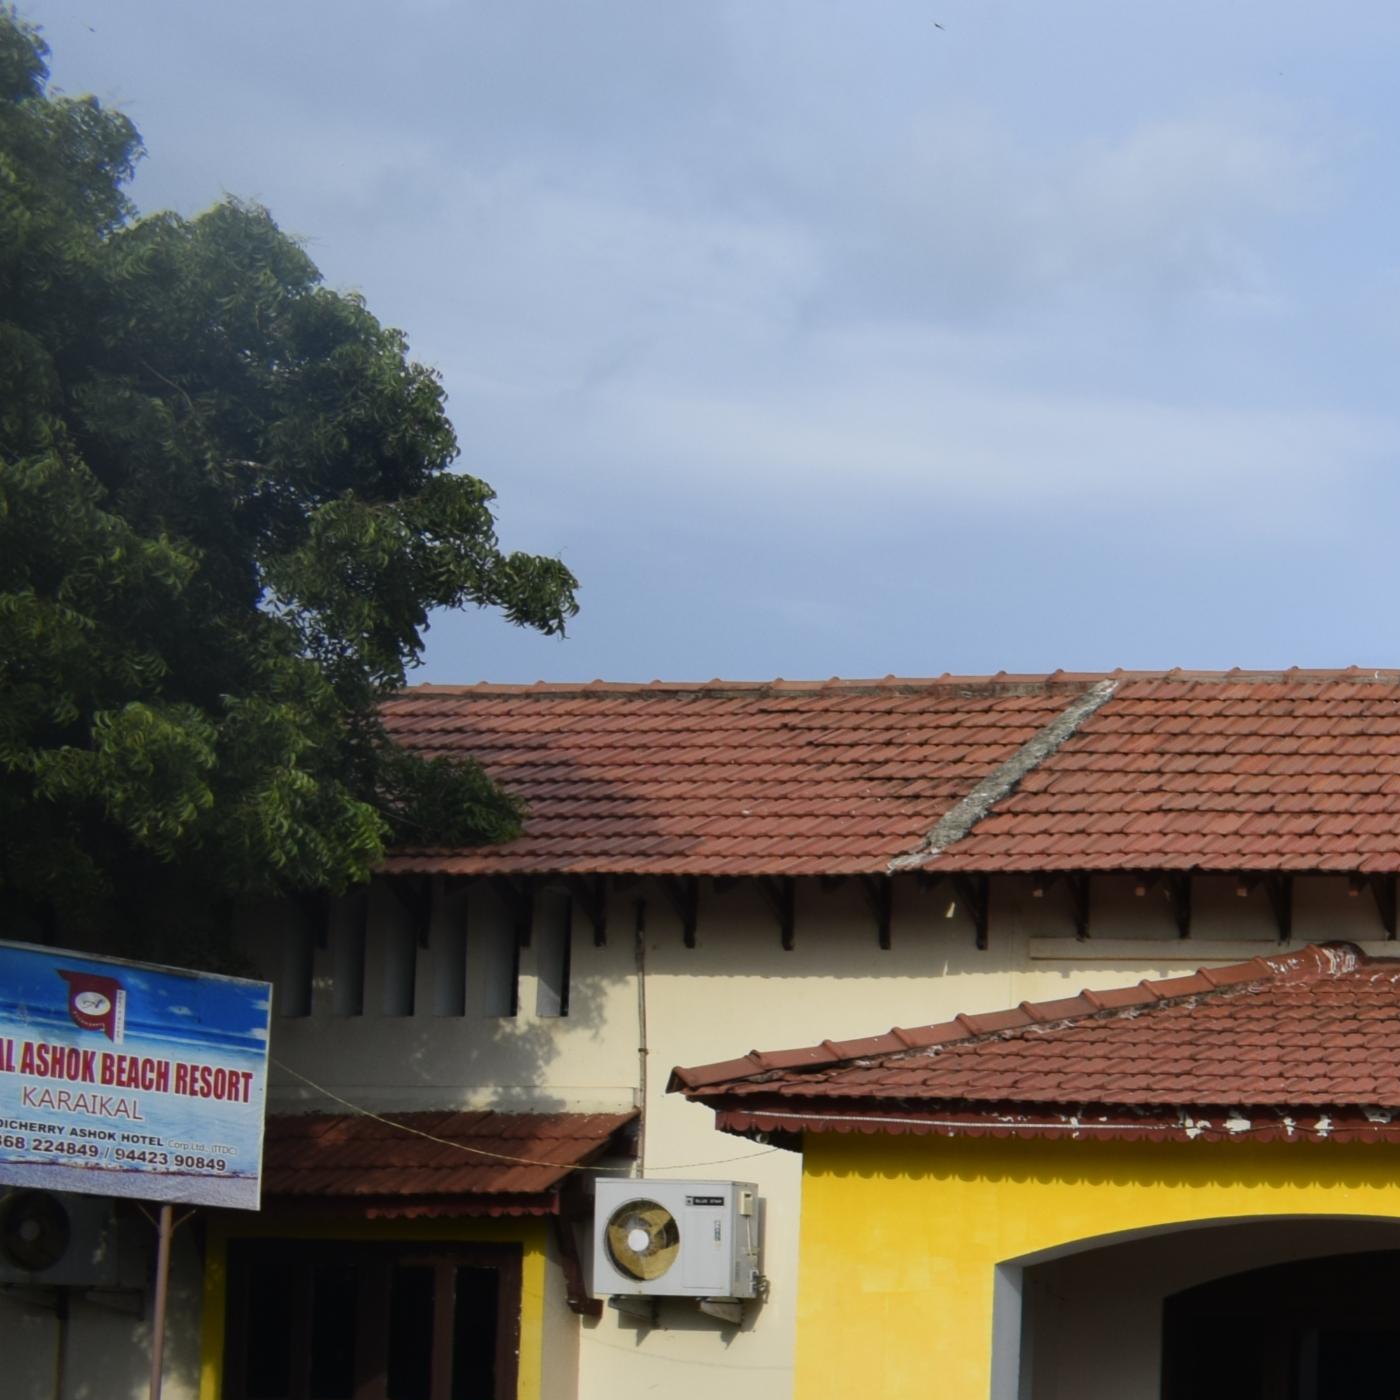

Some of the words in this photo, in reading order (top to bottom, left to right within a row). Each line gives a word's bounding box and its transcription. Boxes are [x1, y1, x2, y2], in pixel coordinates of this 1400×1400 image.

[20, 1041, 96, 1083] ASHOK
[100, 1052, 170, 1093] BEACH
[175, 1062, 253, 1103] RESORT
[22, 1086, 143, 1120] KARAIKAL
[69, 1127, 116, 1142] ASHOK
[121, 1134, 163, 1147] HOTEL
[32, 1138, 98, 1158] 224849
[115, 1147, 168, 1165] 94423
[174, 1154, 226, 1171] 90849
